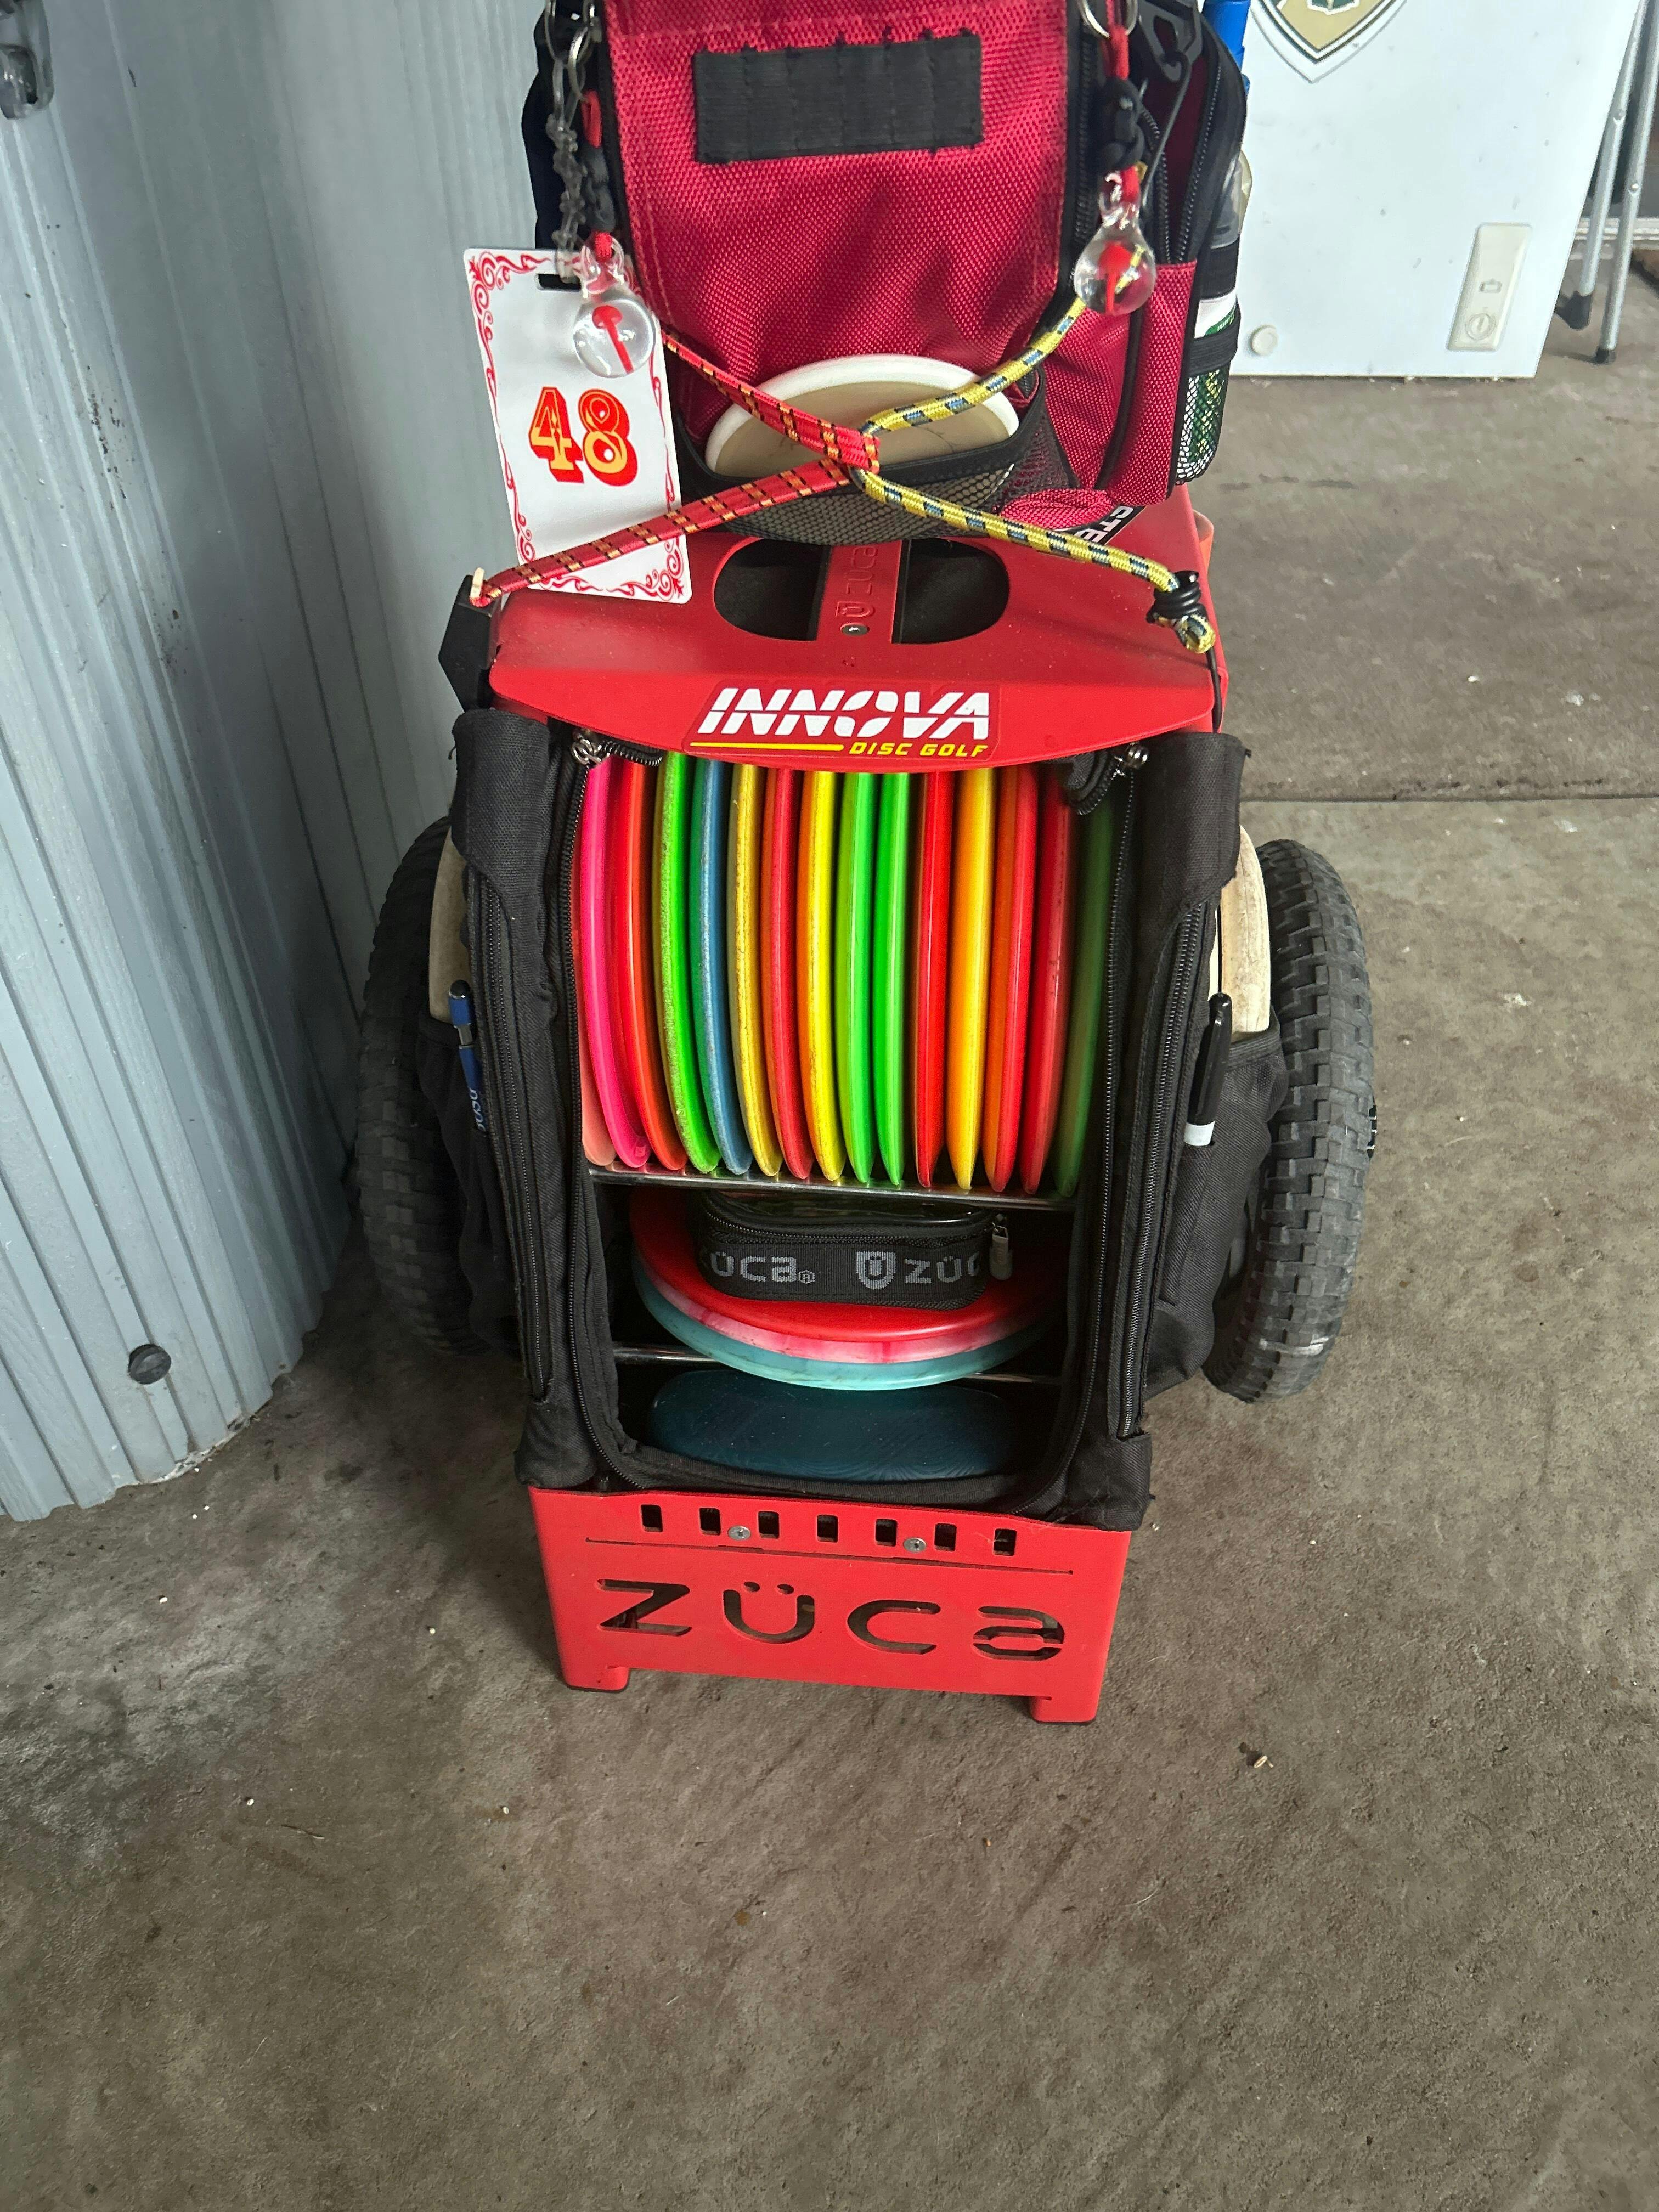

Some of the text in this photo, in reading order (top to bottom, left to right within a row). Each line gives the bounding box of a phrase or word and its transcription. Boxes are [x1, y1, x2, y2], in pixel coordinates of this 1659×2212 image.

[528, 386, 639, 487] 48
[697, 687, 989, 740] INNOVA
[849, 742, 989, 758] DISC GOLF
